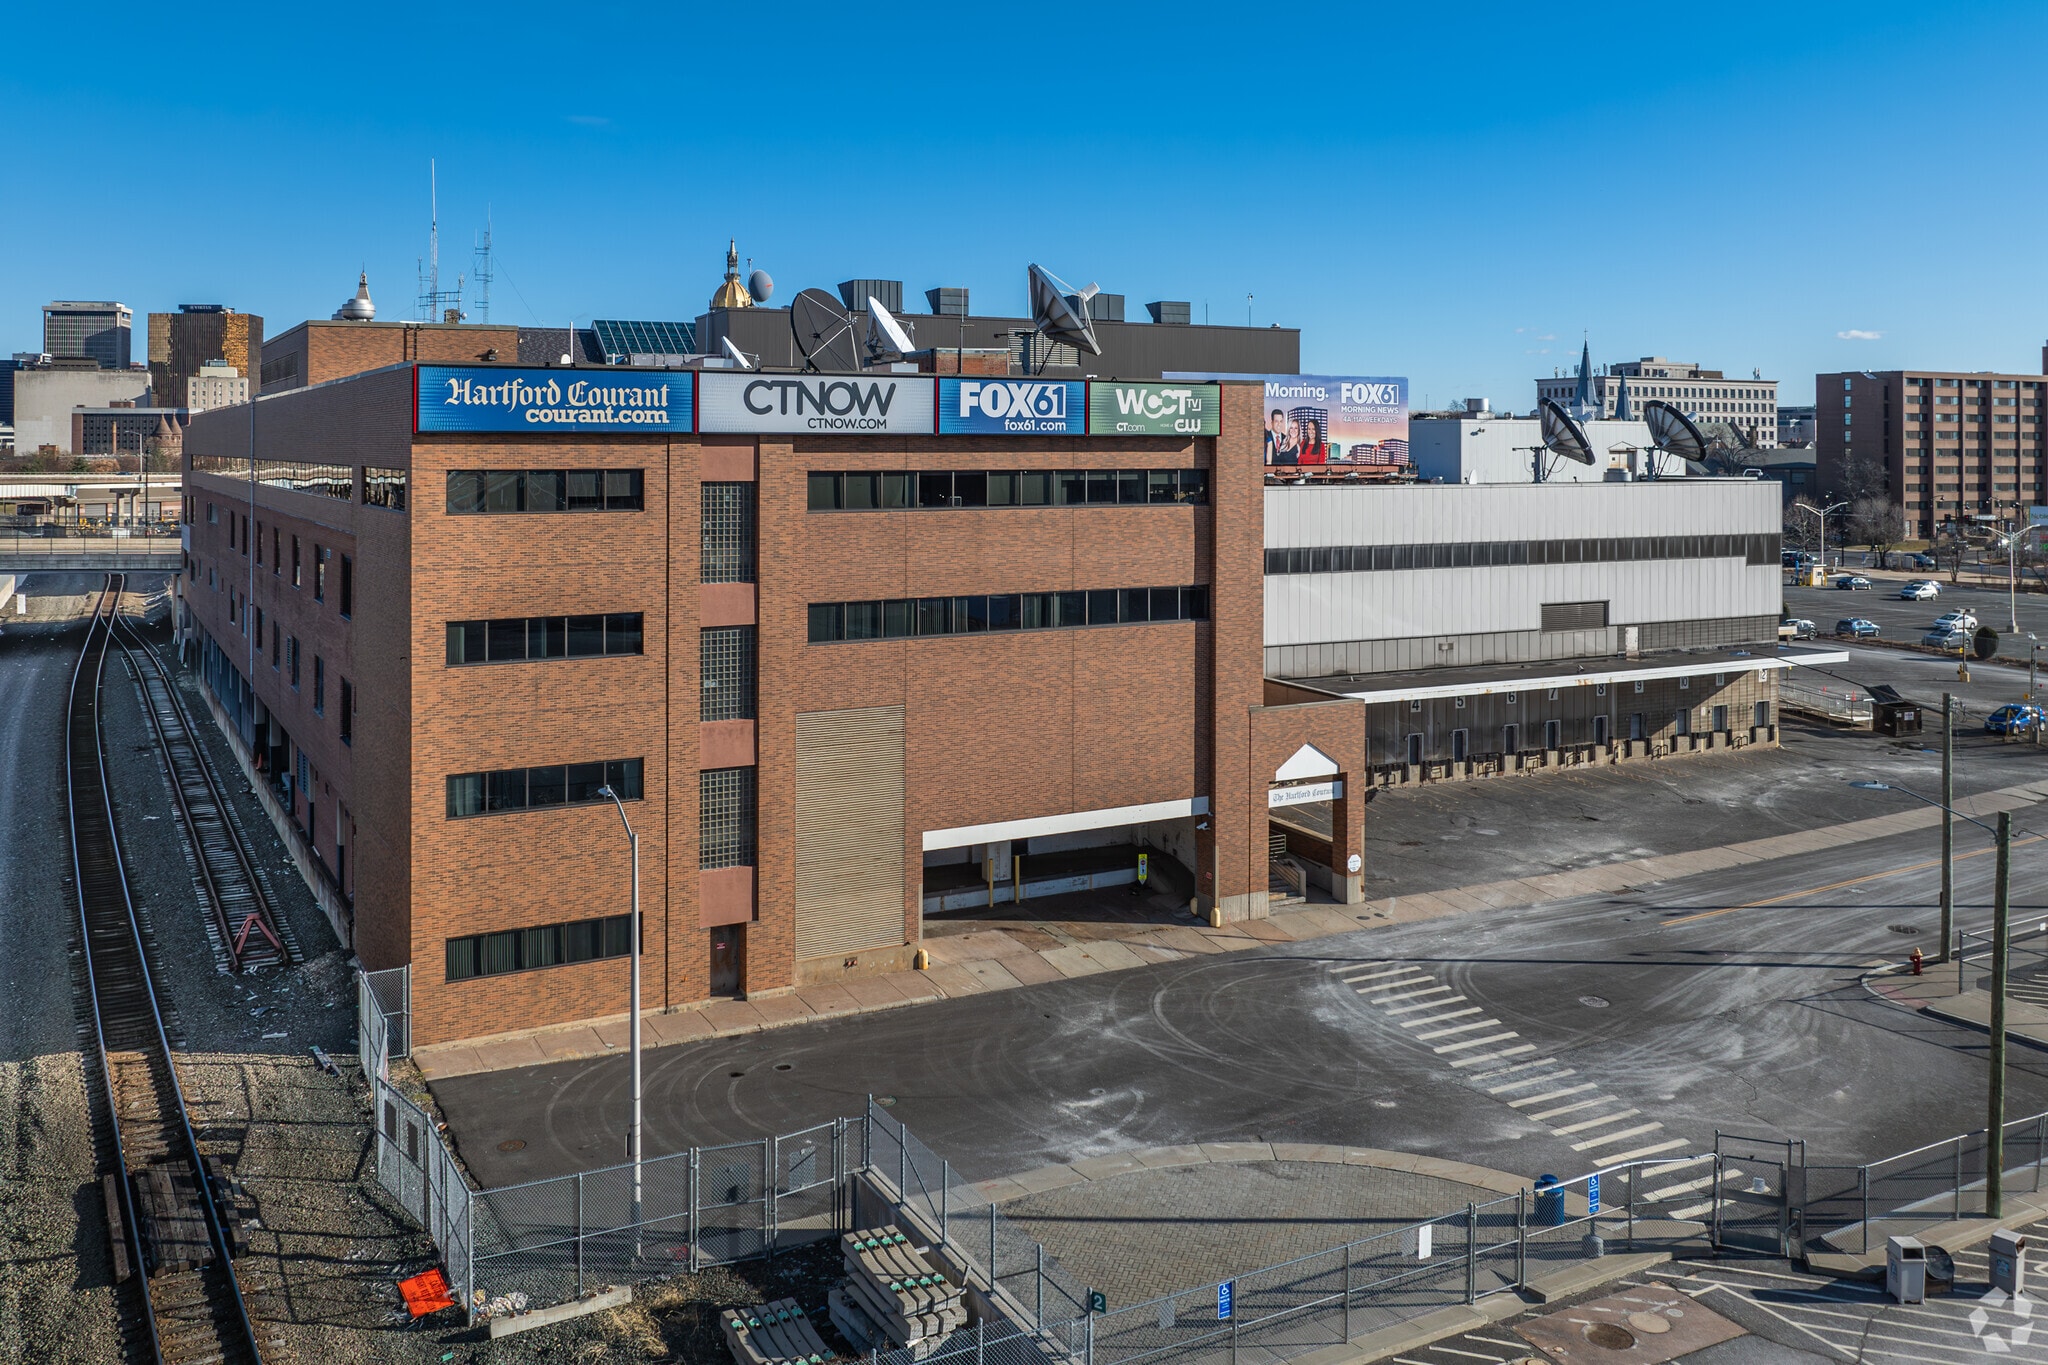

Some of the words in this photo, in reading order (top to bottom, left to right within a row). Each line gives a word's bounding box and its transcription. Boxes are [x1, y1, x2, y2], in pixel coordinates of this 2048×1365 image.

[444, 377, 561, 413] Hartford
[565, 380, 670, 408] Courant
[743, 379, 897, 417] CTNOW
[1265, 382, 1330, 402] Morning.
[1341, 382, 1399, 405] FOX61
[960, 382, 1067, 419] FOX61
[525, 405, 670, 424] courant.com
[1341, 405, 1376, 413] MORNING
[1377, 406, 1399, 414] NEWS
[807, 417, 887, 430] CTNOW.COM
[1004, 418, 1067, 431] fox61.com
[1116, 422, 1146, 432] CT.com
[1174, 418, 1201, 433] CW
[1598, 682, 1605, 694] 8
[1636, 681, 1642, 691] 9
[1508, 691, 1516, 703] 6
[1550, 687, 1557, 699] 7
[1411, 699, 1420, 711] 4
[1457, 696, 1464, 707] 5
[1273, 793, 1284, 802] The
[1285, 790, 1311, 800] Hartford
[1094, 1294, 1103, 1310] 2
